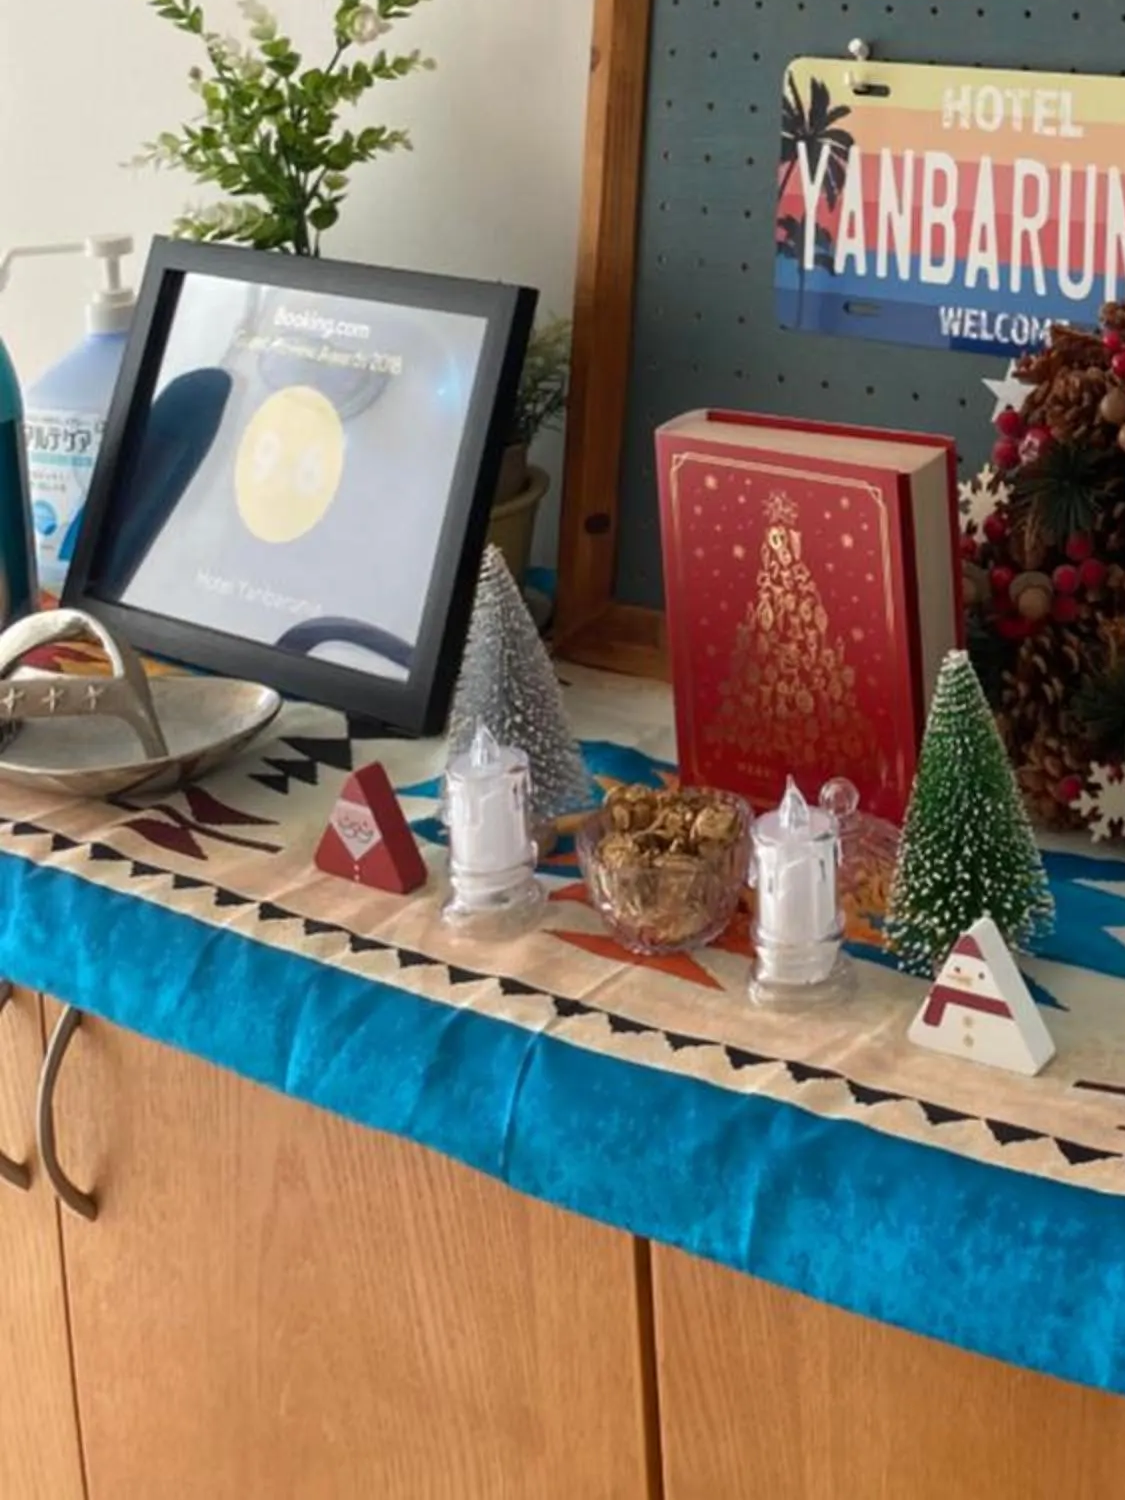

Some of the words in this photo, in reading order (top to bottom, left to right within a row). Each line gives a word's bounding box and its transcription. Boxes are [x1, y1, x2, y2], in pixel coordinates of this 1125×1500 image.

[941, 85, 1084, 139] HOTEL
[273, 305, 370, 339] Booking.com
[938, 305, 1070, 349] WELCOM
